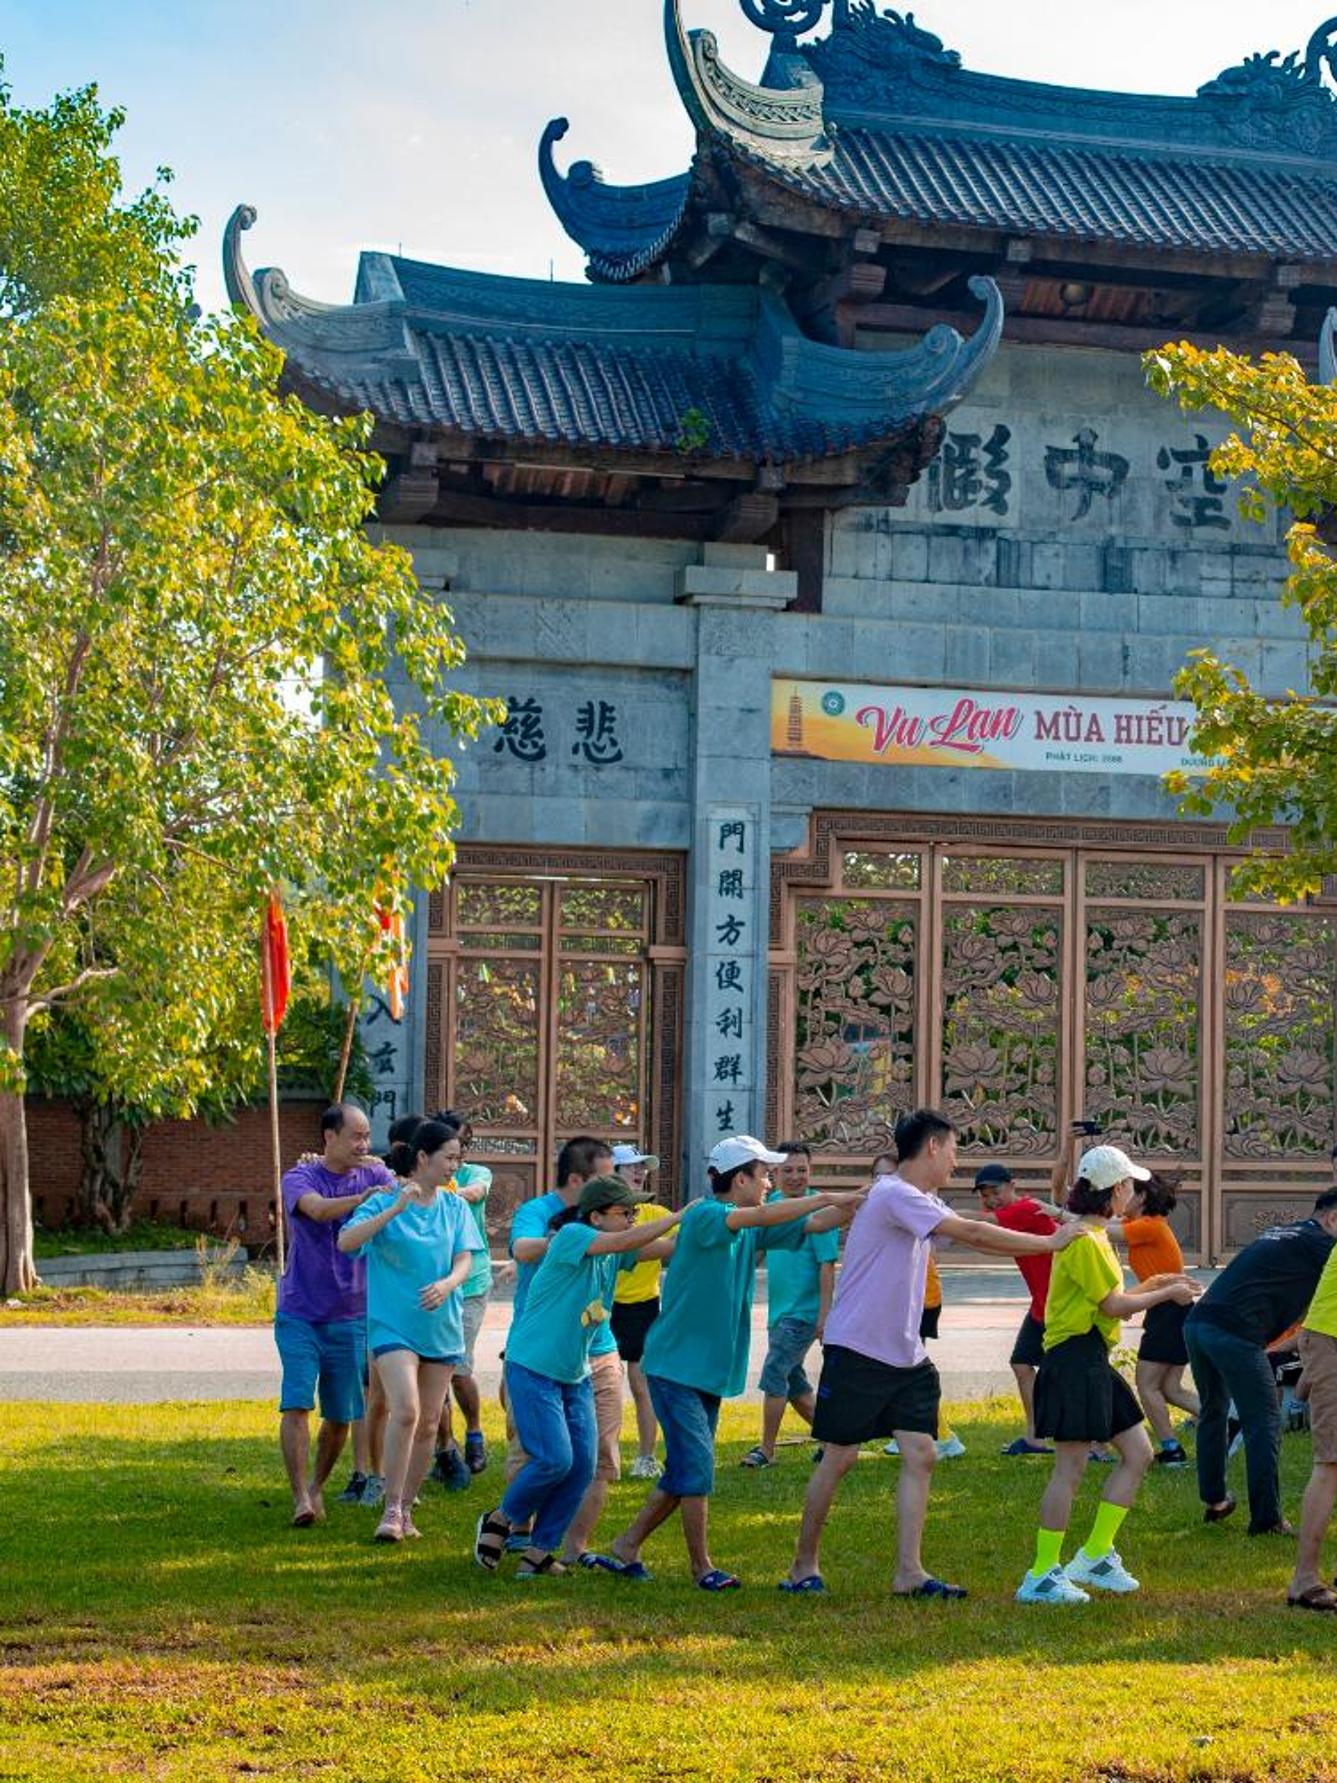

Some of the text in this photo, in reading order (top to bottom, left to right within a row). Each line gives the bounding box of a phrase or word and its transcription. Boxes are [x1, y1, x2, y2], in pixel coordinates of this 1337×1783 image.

[492, 696, 623, 763] 慈悲
[855, 698, 1188, 753] Vu Lan MÙA HIẾU
[714, 821, 746, 1131] 門開方便利群生
